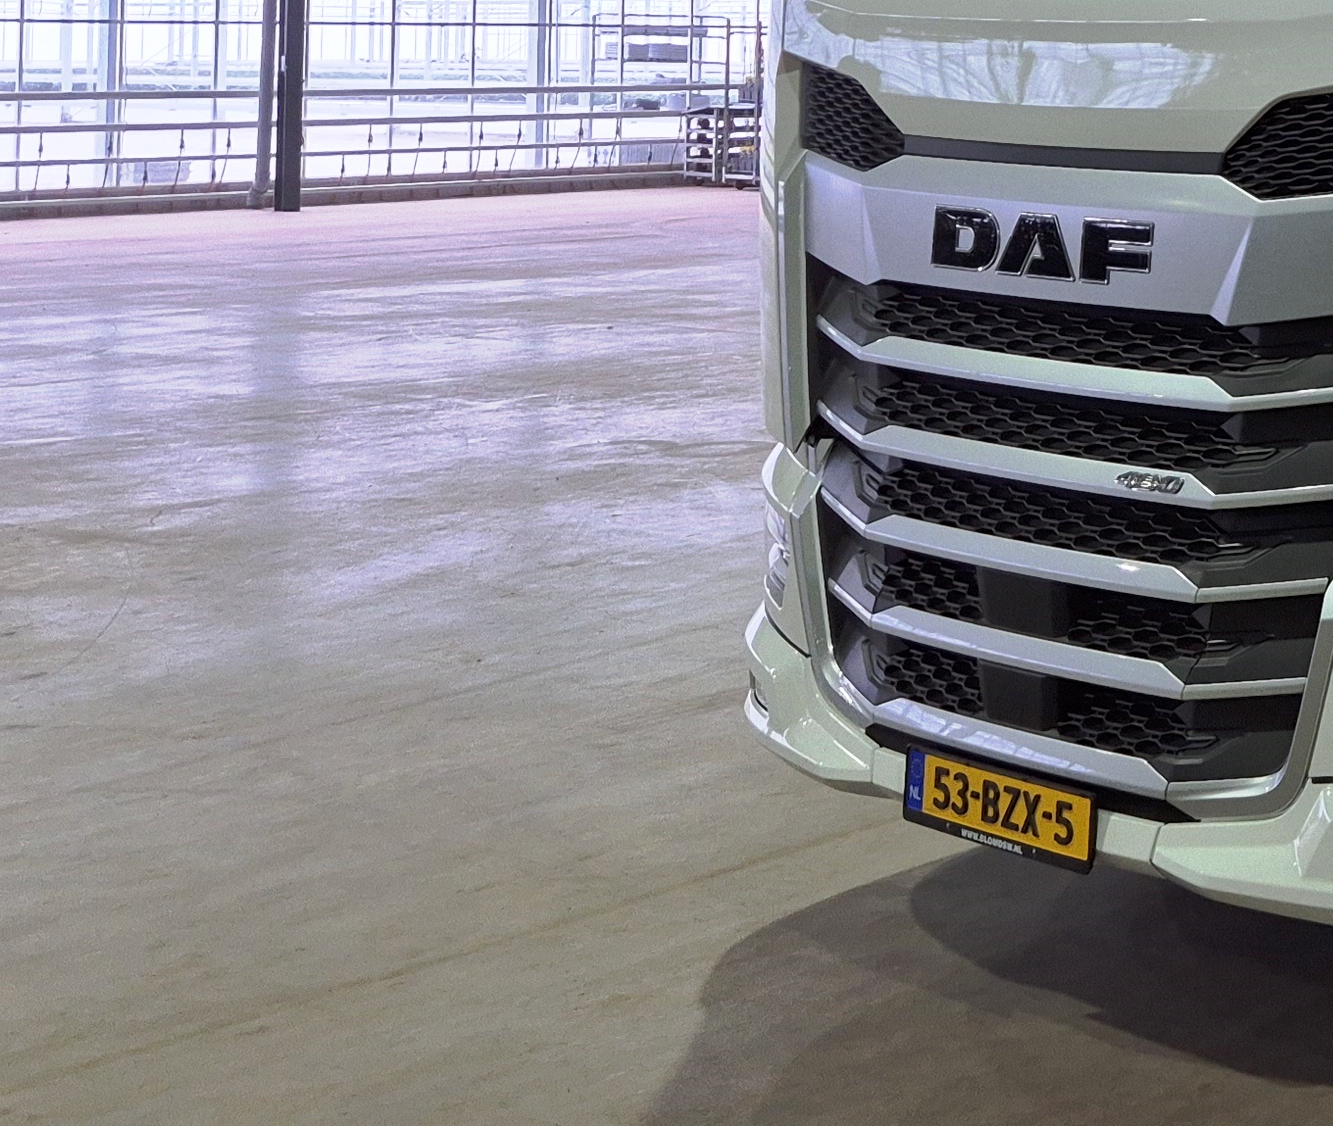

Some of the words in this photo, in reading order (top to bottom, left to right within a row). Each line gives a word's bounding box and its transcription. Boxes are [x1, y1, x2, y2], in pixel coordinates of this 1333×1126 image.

[931, 204, 1155, 285] DAF
[909, 785, 922, 801] NL
[932, 765, 1074, 846] 53-BZX-5
